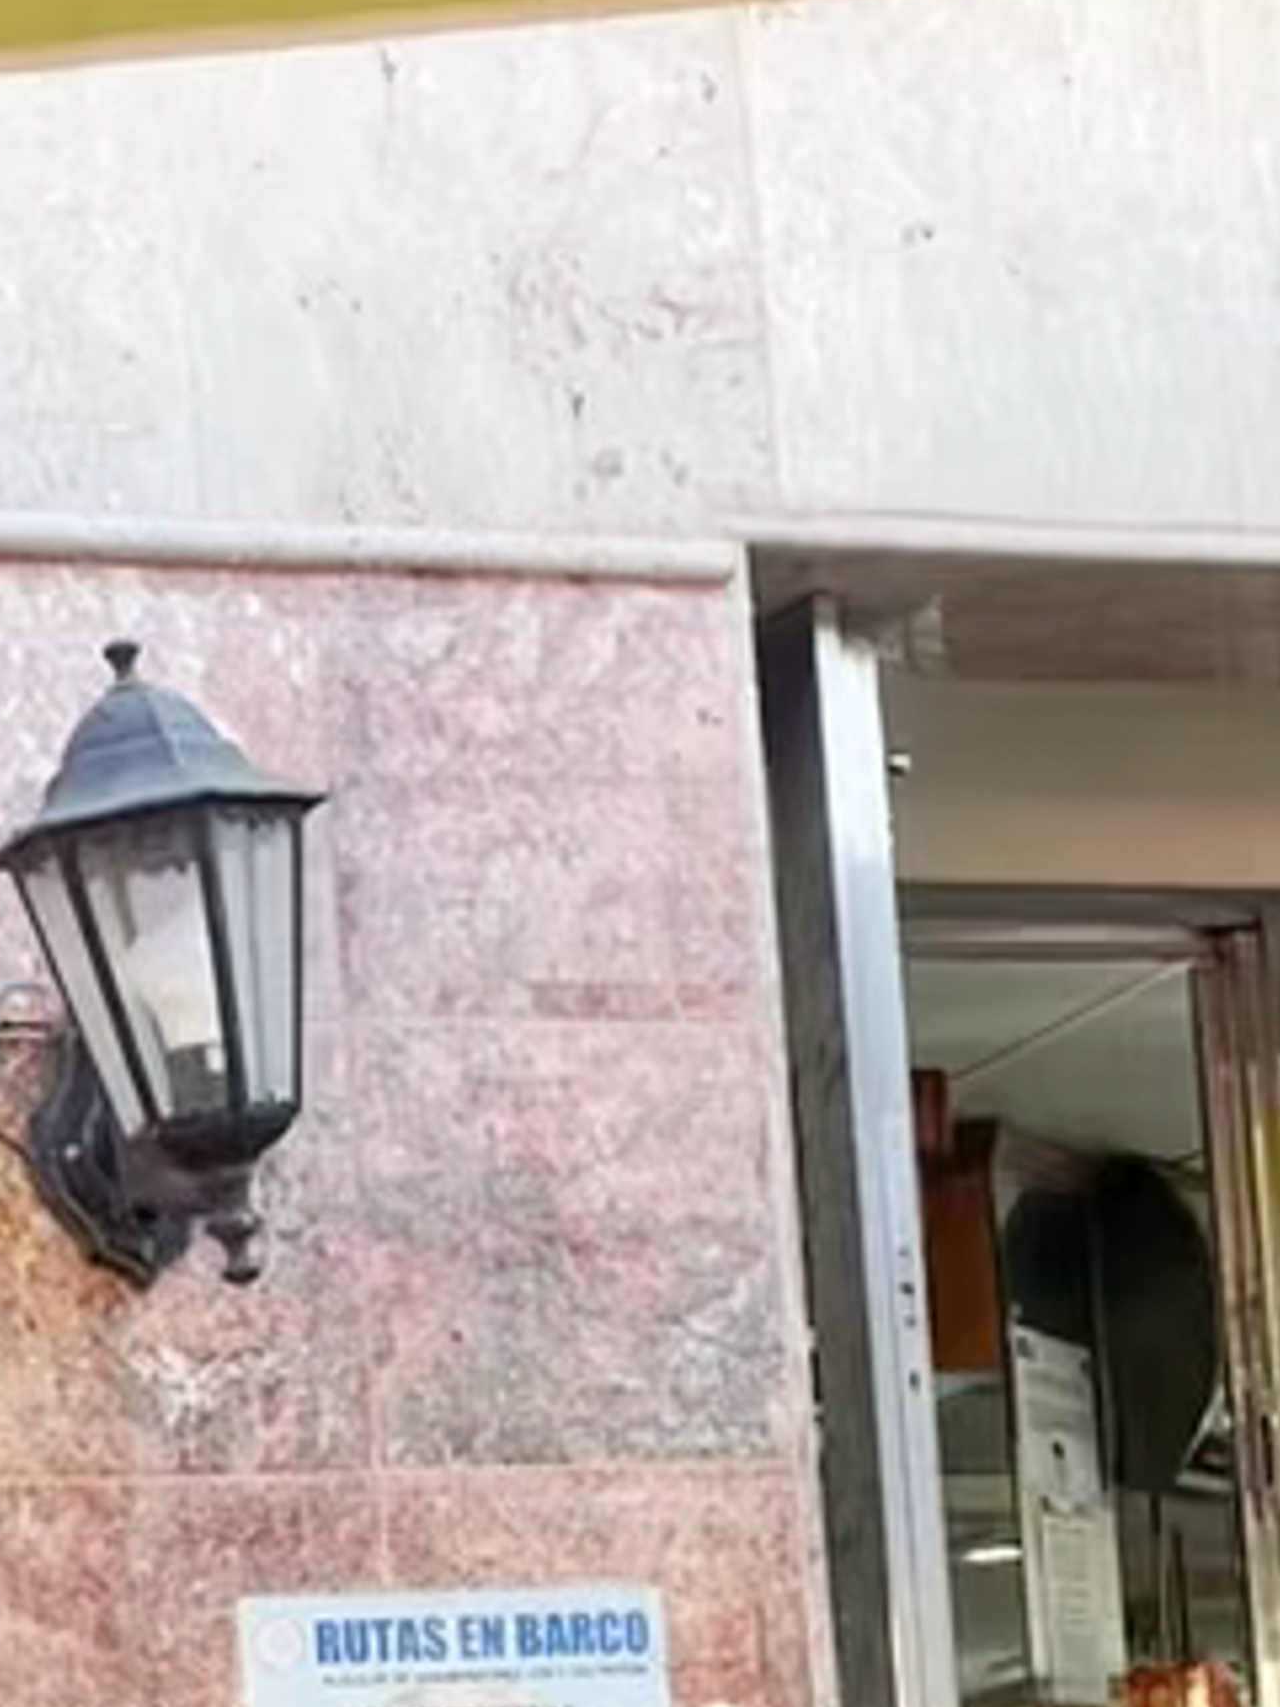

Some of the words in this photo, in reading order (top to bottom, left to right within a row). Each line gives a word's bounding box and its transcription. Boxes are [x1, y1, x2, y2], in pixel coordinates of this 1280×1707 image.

[314, 1616, 448, 1664] RUTAS
[457, 1615, 506, 1660] EN
[516, 1610, 650, 1659] BARCO
